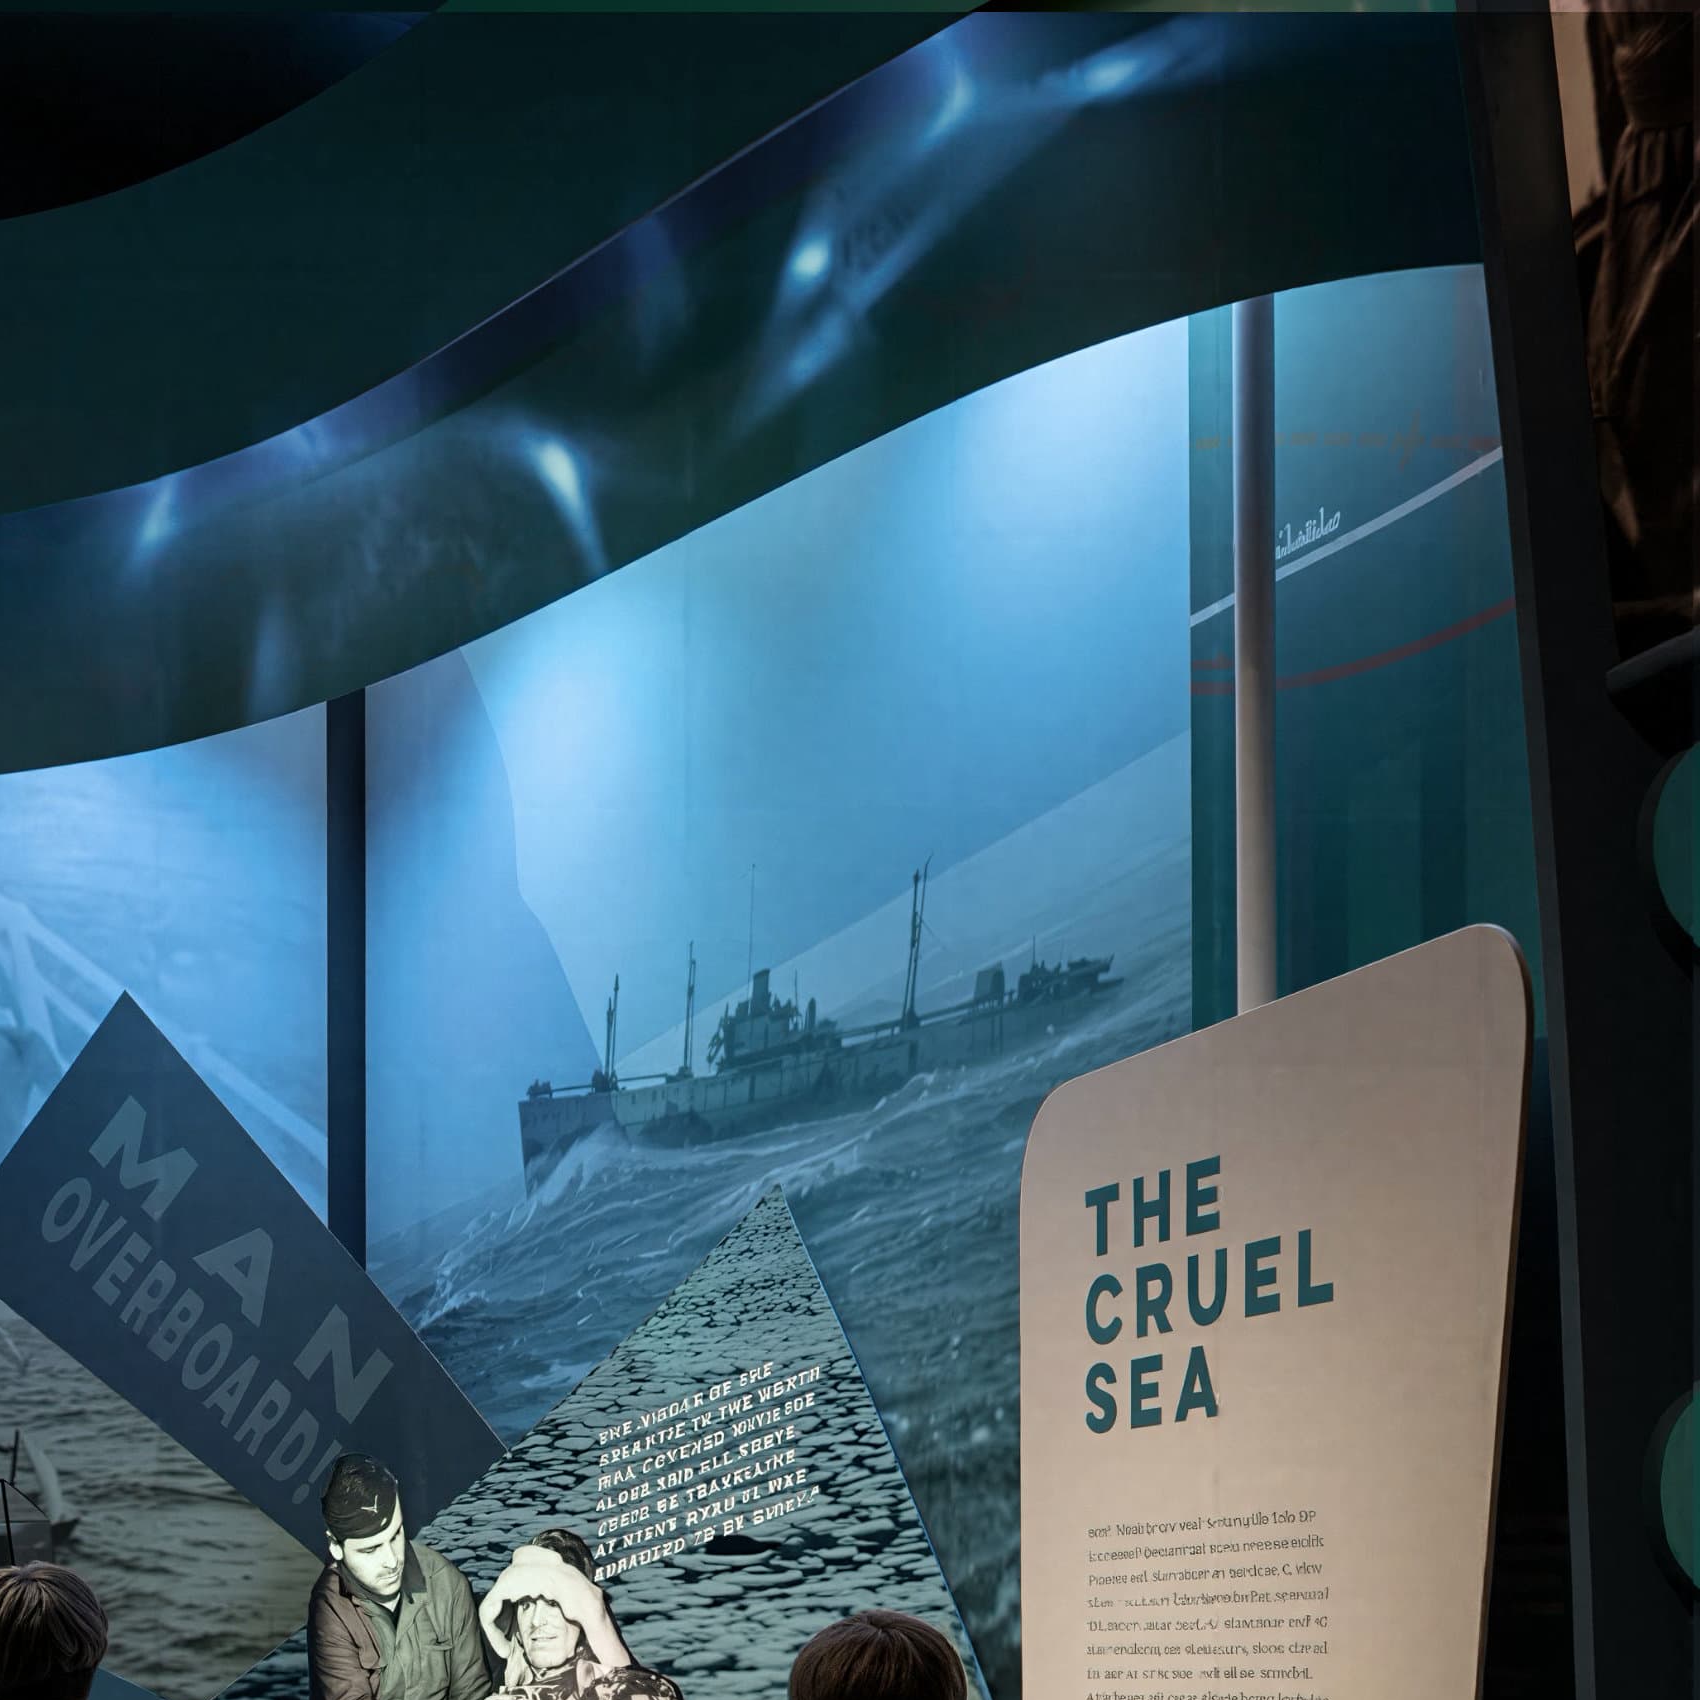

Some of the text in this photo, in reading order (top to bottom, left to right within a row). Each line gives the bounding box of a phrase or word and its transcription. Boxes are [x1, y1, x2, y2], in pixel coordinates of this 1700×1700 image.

[89, 1096, 394, 1425] MAN
[1085, 1155, 1221, 1257] THE
[41, 1177, 343, 1505] OVERBOARD!
[1085, 1228, 1334, 1345] CRUEL
[1085, 1345, 1219, 1434] SEA
